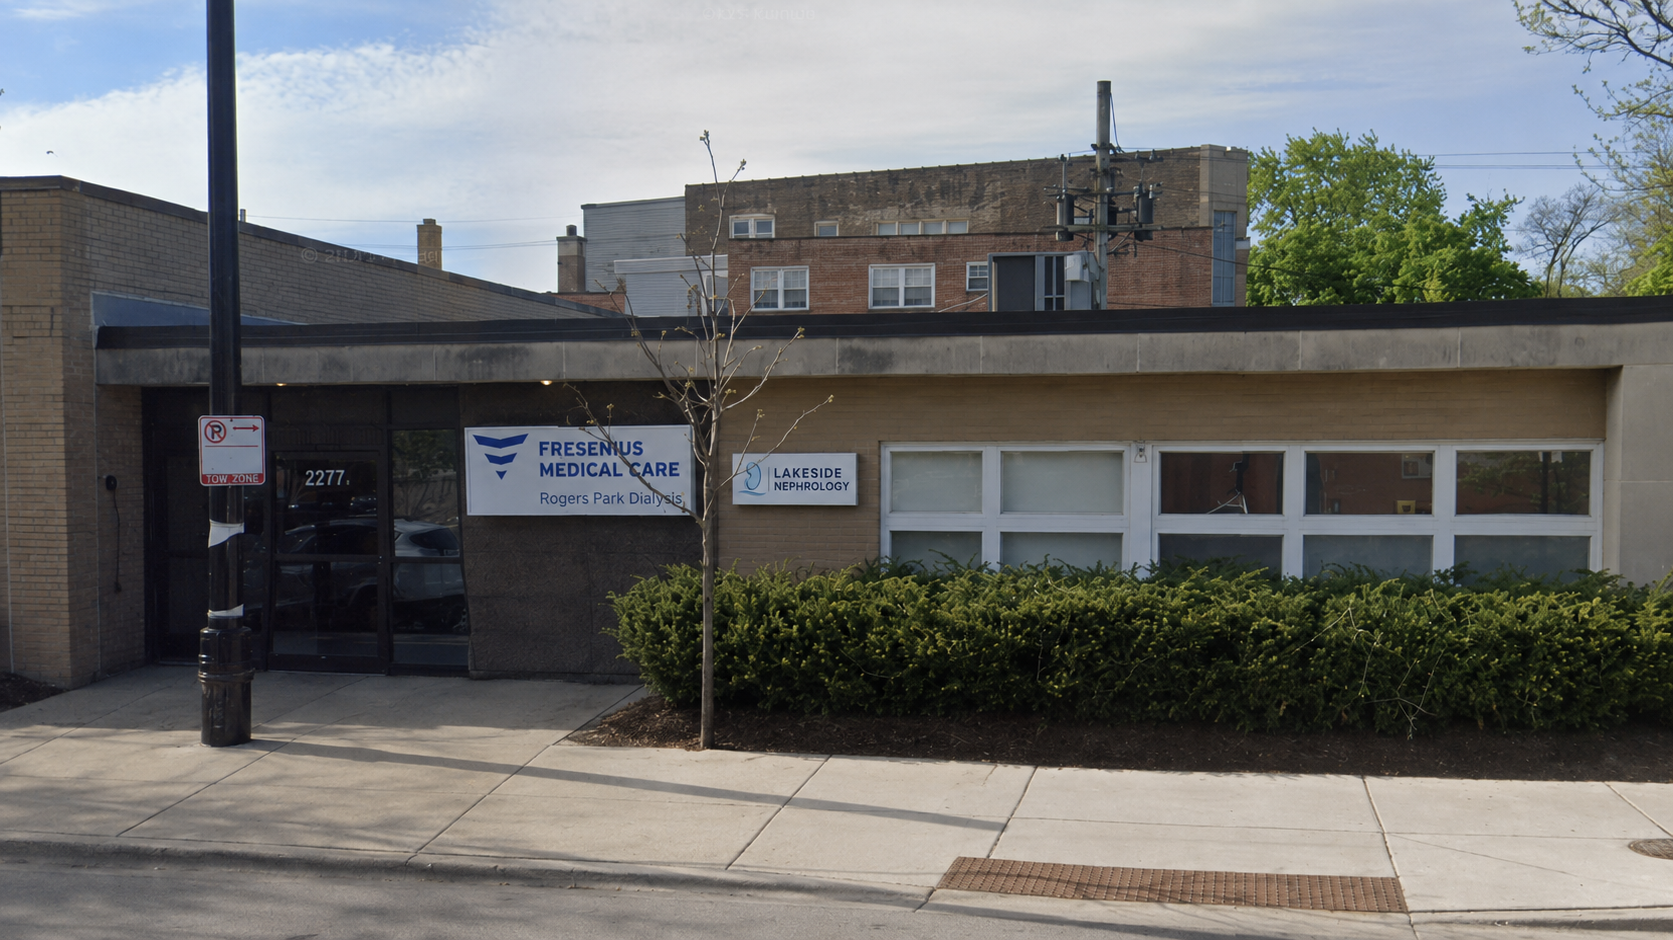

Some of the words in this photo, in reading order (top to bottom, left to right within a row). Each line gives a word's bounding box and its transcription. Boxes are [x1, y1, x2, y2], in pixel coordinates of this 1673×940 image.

[539, 441, 644, 457] FRESENIUS
[539, 462, 623, 478] MEDICAL
[628, 462, 680, 477] CARE
[774, 467, 842, 478] LAKESIDE
[206, 474, 228, 484] TOW
[232, 474, 259, 483] ZONE
[774, 481, 850, 491] NEPHROLOGY
[540, 492, 589, 507] Rogers
[593, 492, 625, 505] Park
[629, 492, 682, 507] Dialysis
